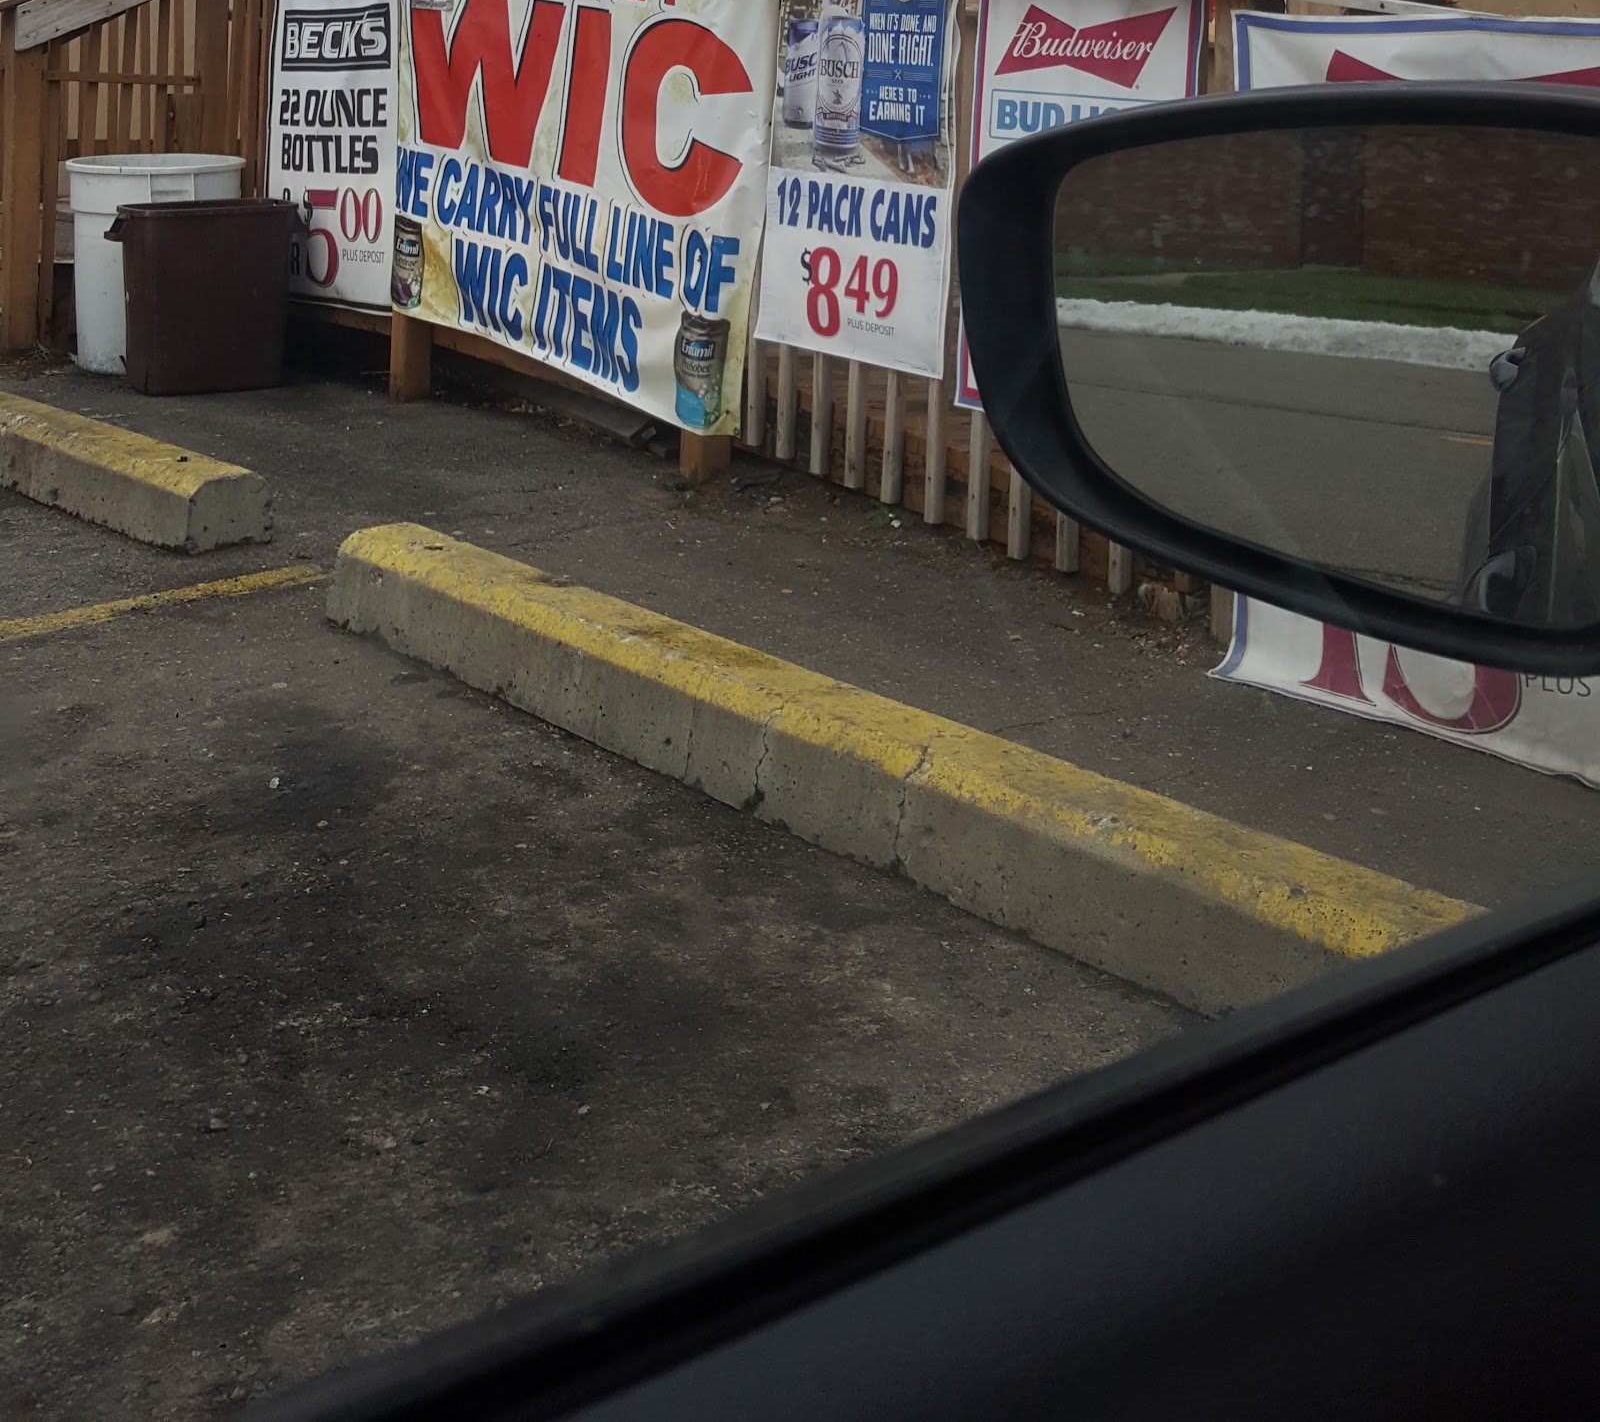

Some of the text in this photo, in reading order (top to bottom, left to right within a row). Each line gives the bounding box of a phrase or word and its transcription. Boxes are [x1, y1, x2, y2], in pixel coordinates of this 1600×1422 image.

[285, 11, 388, 59] BECK'S
[869, 12, 937, 34] WHEN IT'S DONE, AND
[868, 33, 935, 67] DONE RIGHT.
[1013, 21, 1154, 61] Budweiser
[785, 51, 818, 74] BUSC
[789, 67, 816, 82] LIGHT
[820, 58, 860, 79] BUSCH
[279, 88, 388, 128] 22 OUNCE
[879, 85, 918, 103] HERE'S TO
[869, 100, 911, 123] EARNING
[915, 105, 926, 126] IT
[996, 98, 1065, 133] BUD
[281, 133, 379, 174] BOTTLES
[777, 176, 938, 249] 12 PACK CANS
[437, 157, 535, 246] CARRY
[539, 184, 600, 275] FULL
[606, 206, 675, 301] LINE
[683, 228, 741, 313] OF
[343, 248, 385, 264] PLUS DEPOSIT
[455, 238, 642, 393] WIC ITEMS
[847, 317, 895, 337] PLUS DEPOSIT
[682, 339, 714, 358] Enfamil
